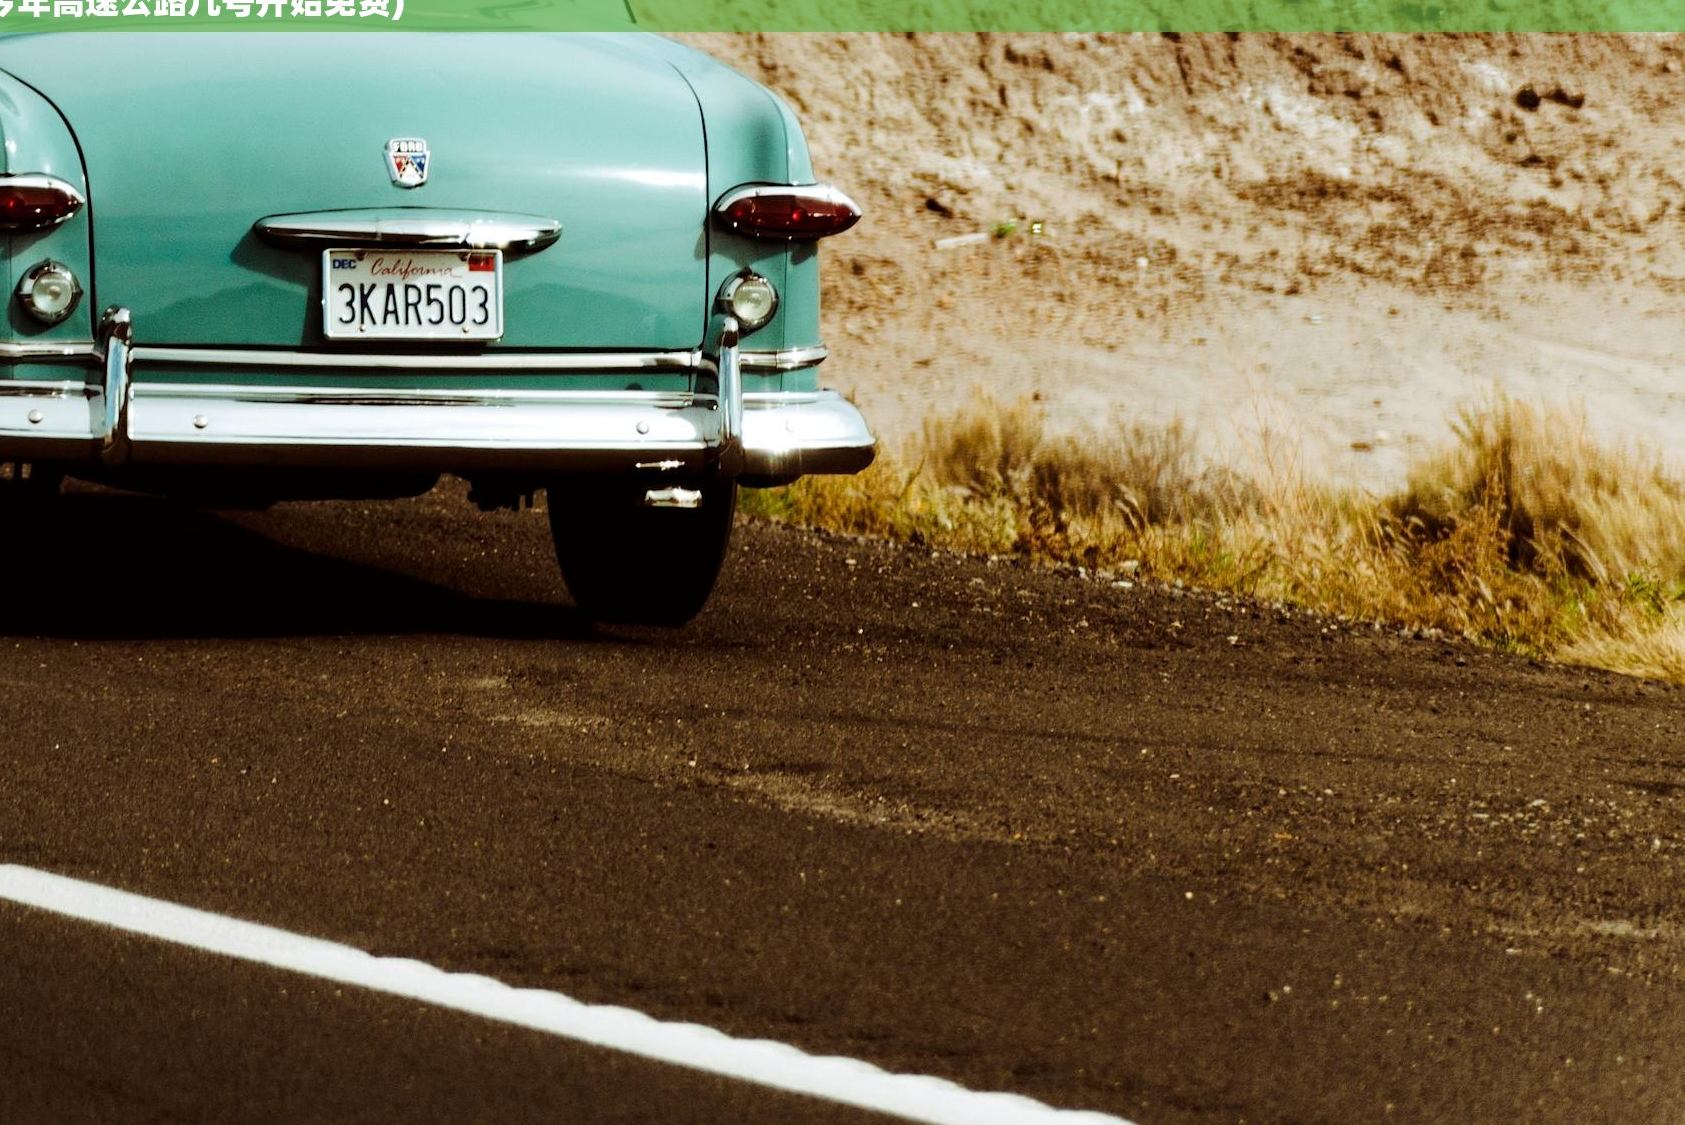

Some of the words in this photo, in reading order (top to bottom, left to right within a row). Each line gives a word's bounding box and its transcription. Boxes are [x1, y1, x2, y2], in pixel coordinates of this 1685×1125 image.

[332, 259, 357, 270] DEC
[370, 257, 462, 280] California
[338, 282, 490, 326] 3KAR503
